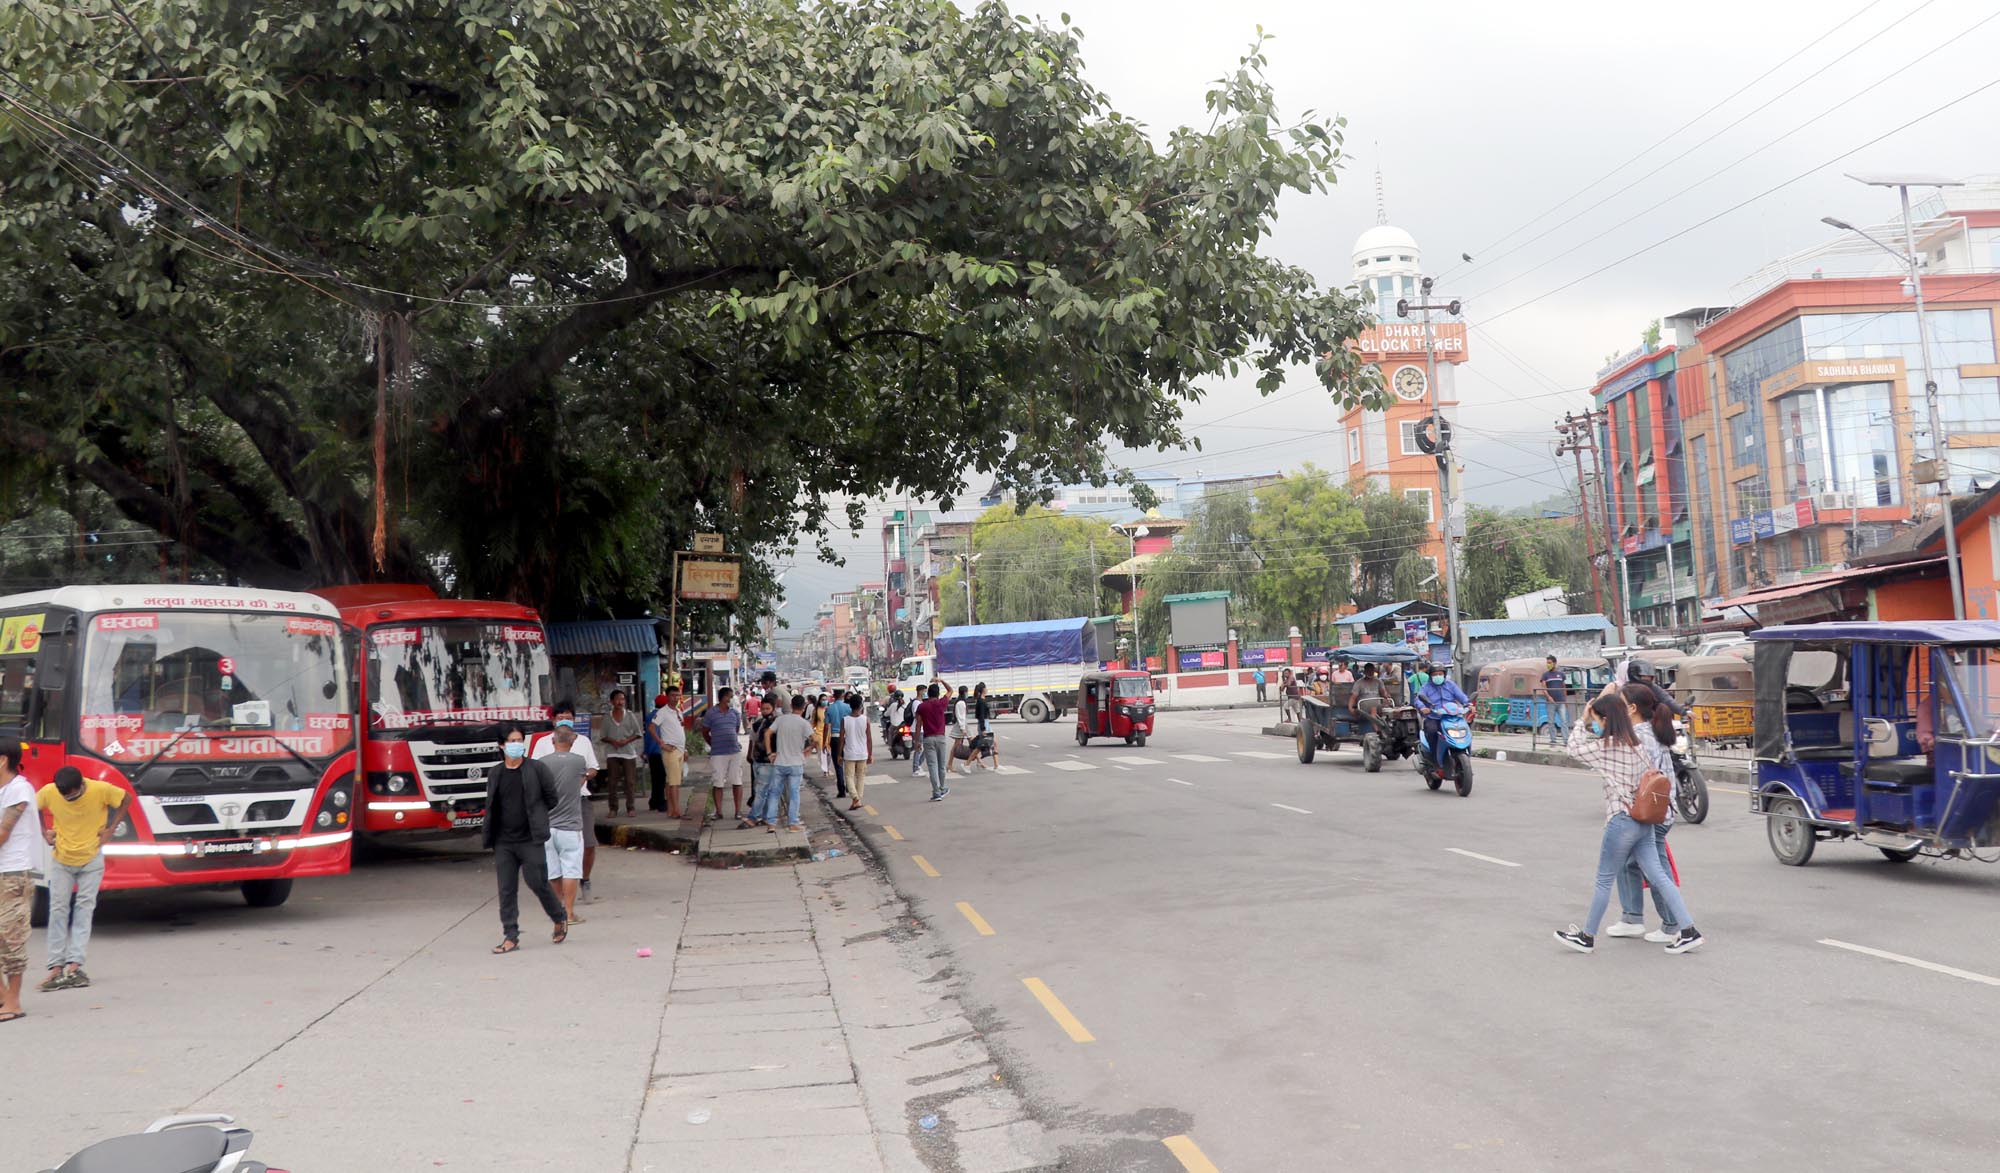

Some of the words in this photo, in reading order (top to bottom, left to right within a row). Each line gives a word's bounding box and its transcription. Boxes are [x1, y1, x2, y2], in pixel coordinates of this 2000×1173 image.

[1385, 325, 1436, 337] DHARAN
[1361, 339, 1409, 352] CLOCK
[1817, 365, 1859, 377] SADHANA
[1860, 363, 1896, 375] BHAWAN
[191, 598, 245, 608] महाराज
[249, 599, 269, 609] की
[274, 602, 297, 611] जय
[219, 736, 324, 754] यातायात
